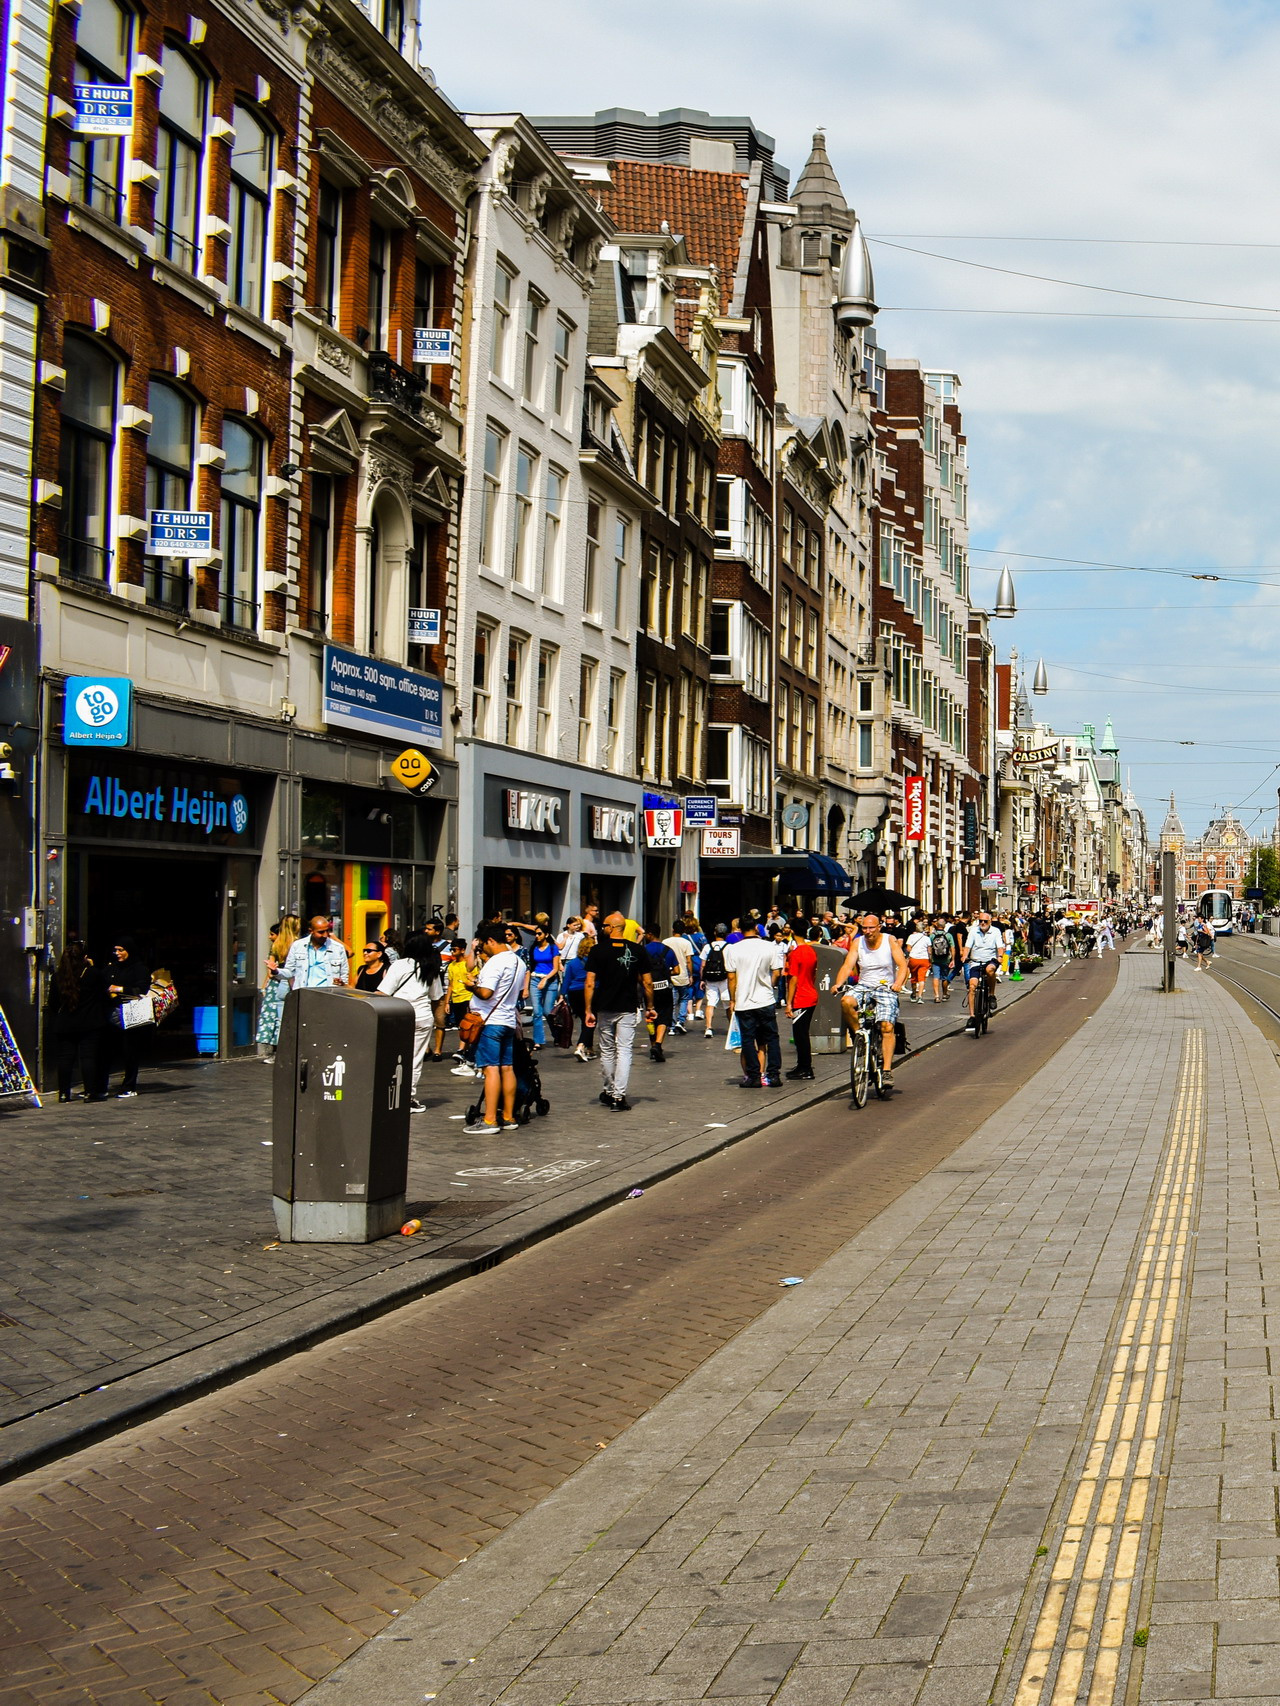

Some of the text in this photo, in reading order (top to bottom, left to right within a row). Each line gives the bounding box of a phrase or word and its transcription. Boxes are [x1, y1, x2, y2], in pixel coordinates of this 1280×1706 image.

[75, 88, 129, 100] TE HUUR
[422, 331, 447, 339] HUUR
[155, 514, 206, 525] TE HUUR
[410, 611, 436, 619] HUUR
[331, 656, 439, 701] Approx. 500 sqm. office space
[84, 691, 105, 707] to
[331, 681, 377, 703] Units from 140 sqm.
[90, 702, 113, 723] go
[95, 732, 115, 740] Heijn
[420, 778, 435, 792] cash
[84, 775, 227, 834] Albert Heijn
[233, 799, 243, 814] to
[520, 791, 562, 834] KFC
[235, 812, 247, 832] go
[602, 807, 635, 844] KFC
[393, 875, 402, 890] 89
